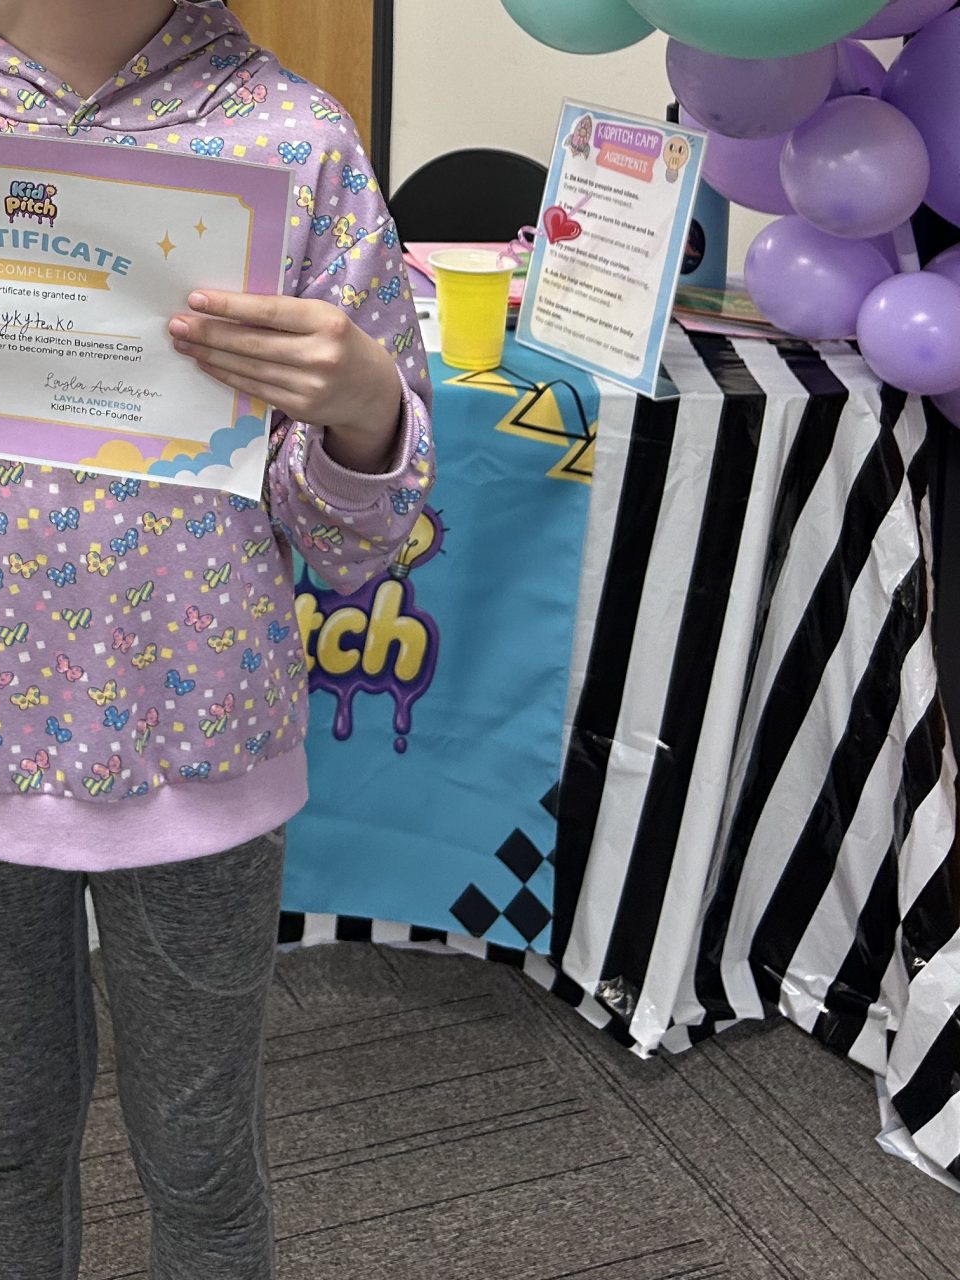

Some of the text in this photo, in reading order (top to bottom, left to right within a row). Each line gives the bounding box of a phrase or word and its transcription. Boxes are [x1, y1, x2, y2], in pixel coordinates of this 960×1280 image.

[597, 123, 659, 150] KIDPITCH CAMP
[603, 151, 648, 174] AGREEMENTS
[11, 181, 44, 200] Kid
[6, 196, 56, 217] Pitch
[33, 289, 40, 297] is
[42, 290, 76, 300] granted
[78, 294, 88, 302] to:
[19, 345, 64, 356] becoming
[66, 349, 77, 357] an
[79, 351, 142, 362] entrepreneur!
[35, 336, 72, 346] KidPitch
[75, 339, 114, 350] Business
[116, 343, 144, 354] Camp
[44, 371, 162, 399] Layla Anderson
[50, 402, 143, 422] KidPitch Co-Founder
[54, 394, 141, 412] LAYLA ANDERSON
